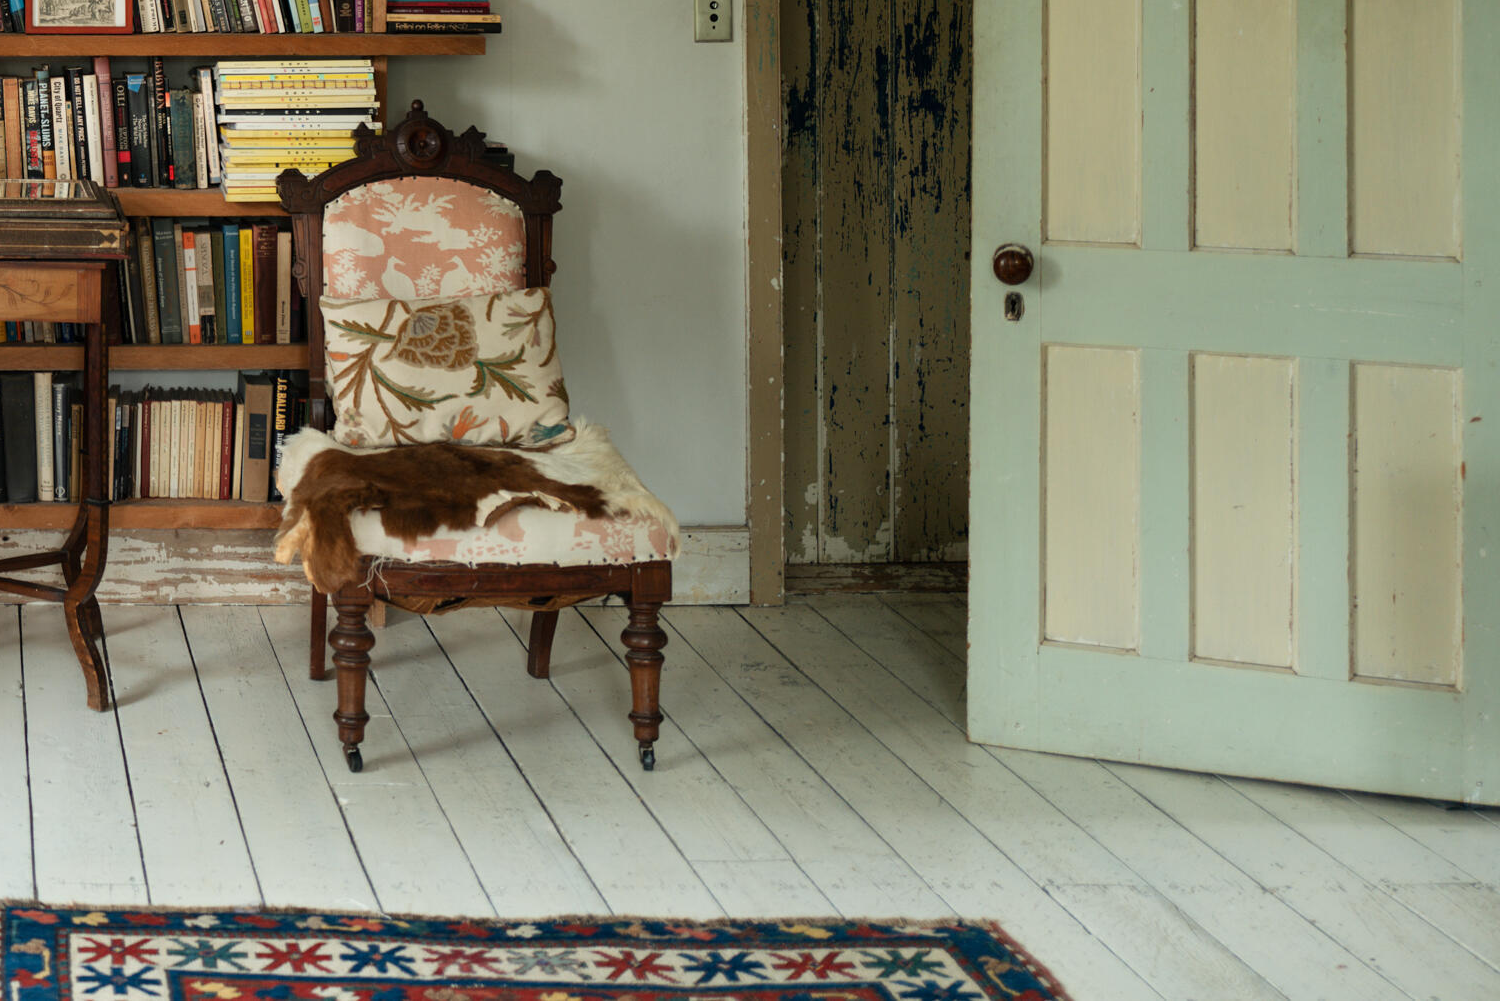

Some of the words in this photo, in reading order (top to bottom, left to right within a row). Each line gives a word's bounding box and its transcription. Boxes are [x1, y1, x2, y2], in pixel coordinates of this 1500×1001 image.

[53, 81, 61, 93] City
[155, 61, 164, 109] BABYLON
[27, 90, 35, 105] MIKE
[38, 82, 49, 113] PLANET
[116, 85, 125, 107] OIL!
[55, 102, 63, 123] Quartz
[41, 118, 51, 147] SLUMS
[77, 127, 85, 142] PRICE
